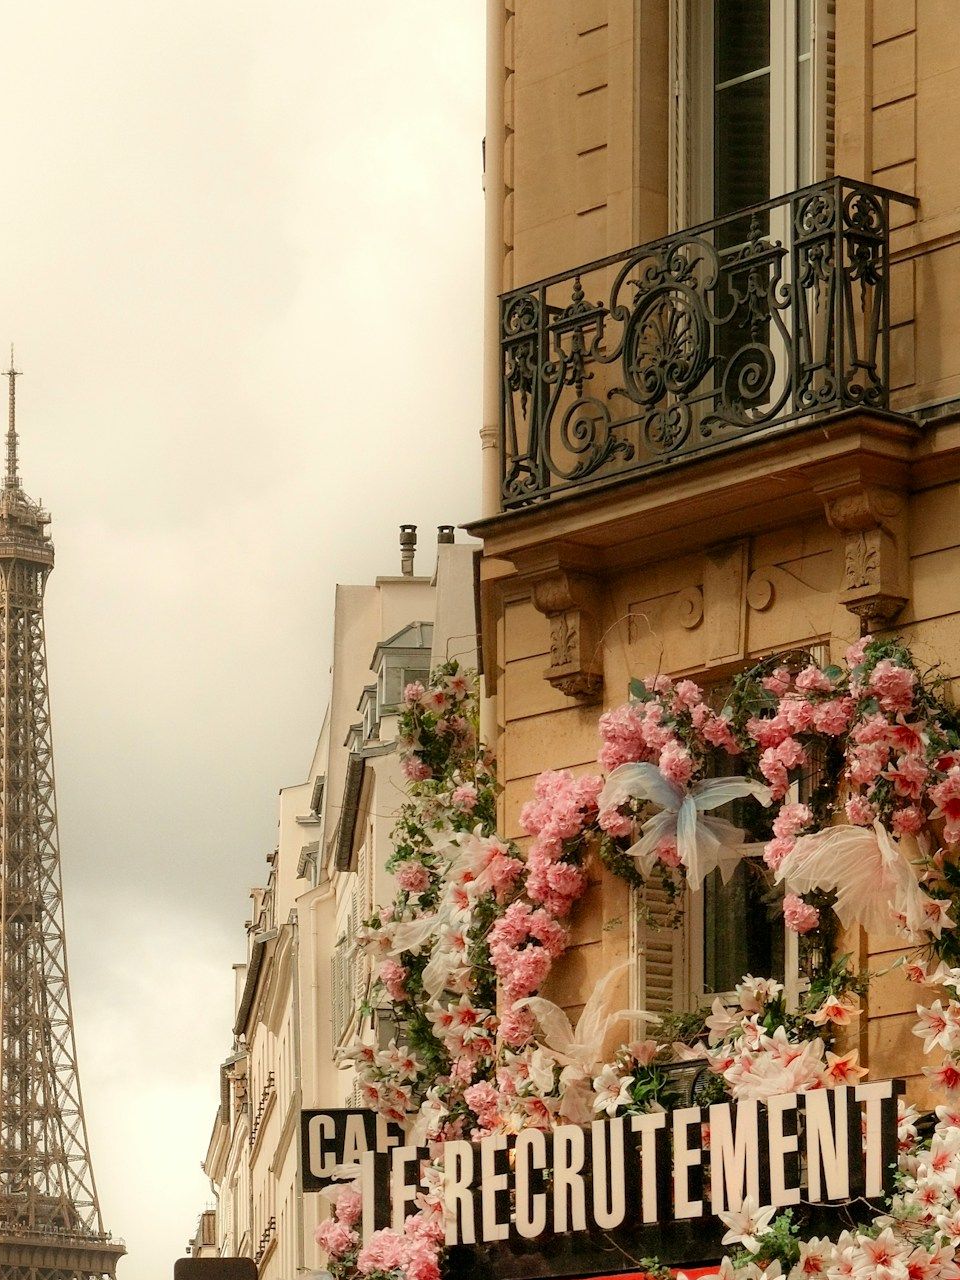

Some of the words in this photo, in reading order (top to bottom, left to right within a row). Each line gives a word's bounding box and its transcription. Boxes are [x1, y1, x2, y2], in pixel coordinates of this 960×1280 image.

[308, 1113, 417, 1179] CAF
[362, 1145, 417, 1247] LE
[444, 1081, 893, 1246] RECRUTEMENT
